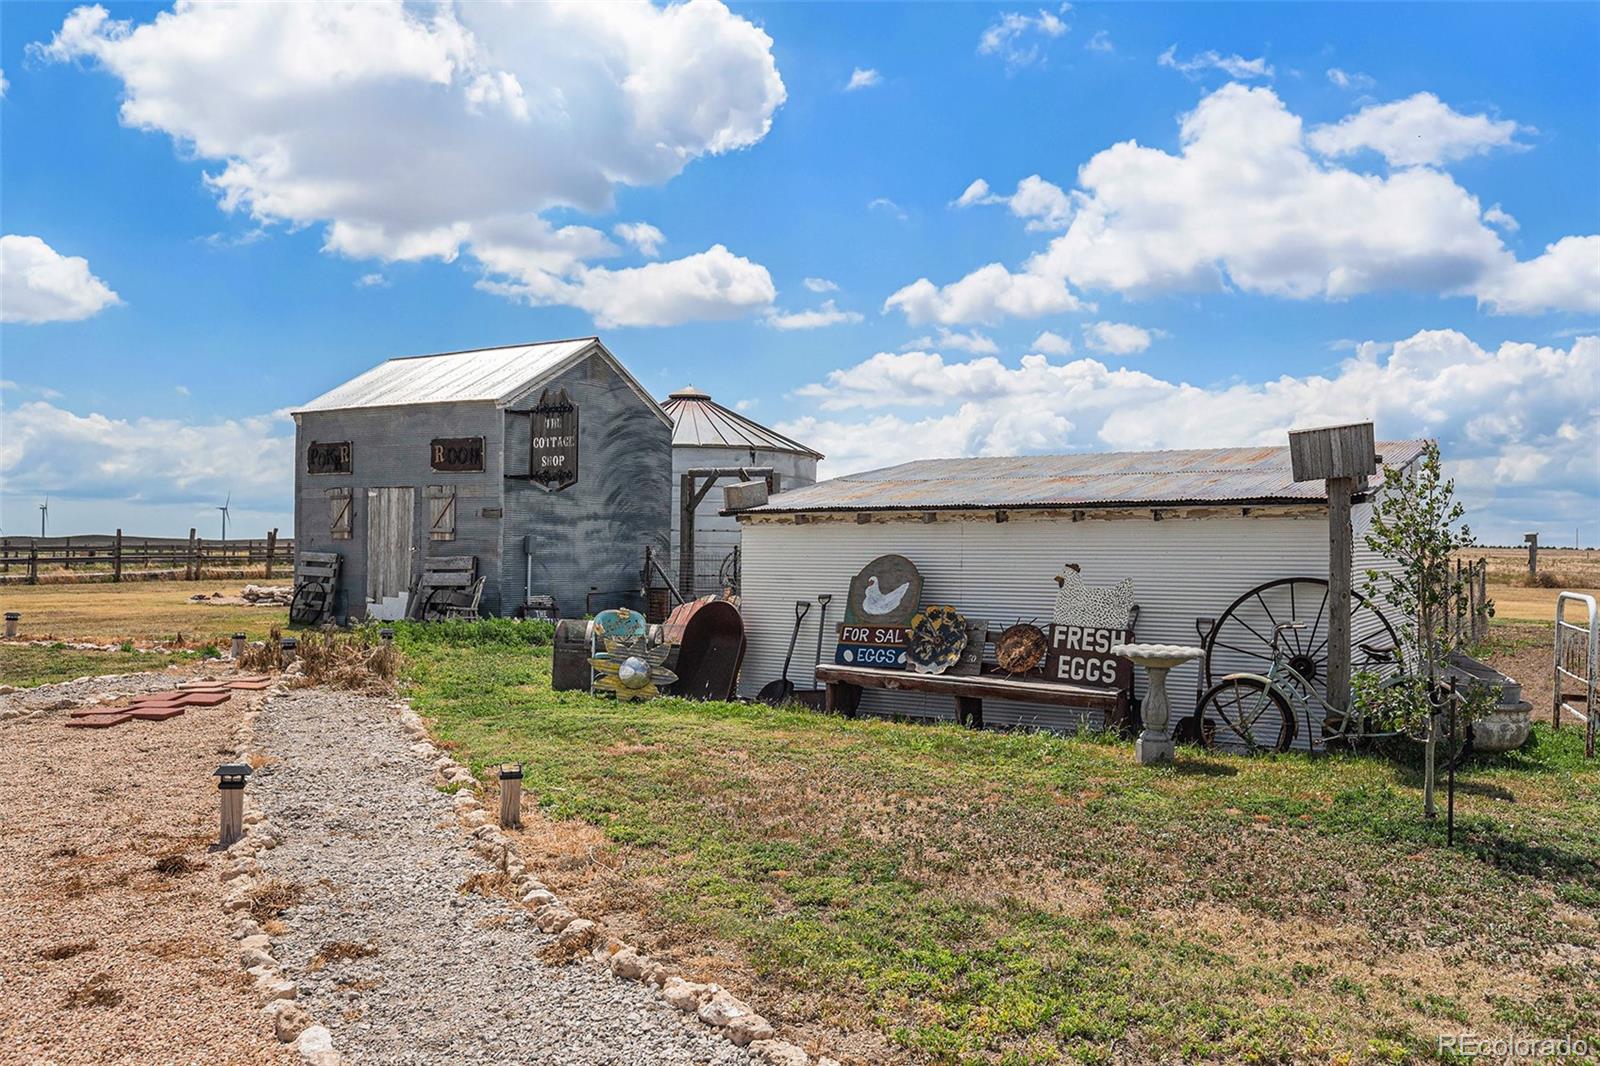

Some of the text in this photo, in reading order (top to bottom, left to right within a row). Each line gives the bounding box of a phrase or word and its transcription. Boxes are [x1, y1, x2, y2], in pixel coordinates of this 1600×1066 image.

[533, 436, 575, 448] COTTAGE
[541, 455, 565, 467] SHOP
[842, 627, 869, 642] FOR
[1053, 625, 1126, 654] FRESH
[857, 648, 896, 664] EGGS
[1057, 655, 1117, 684] EGGS
